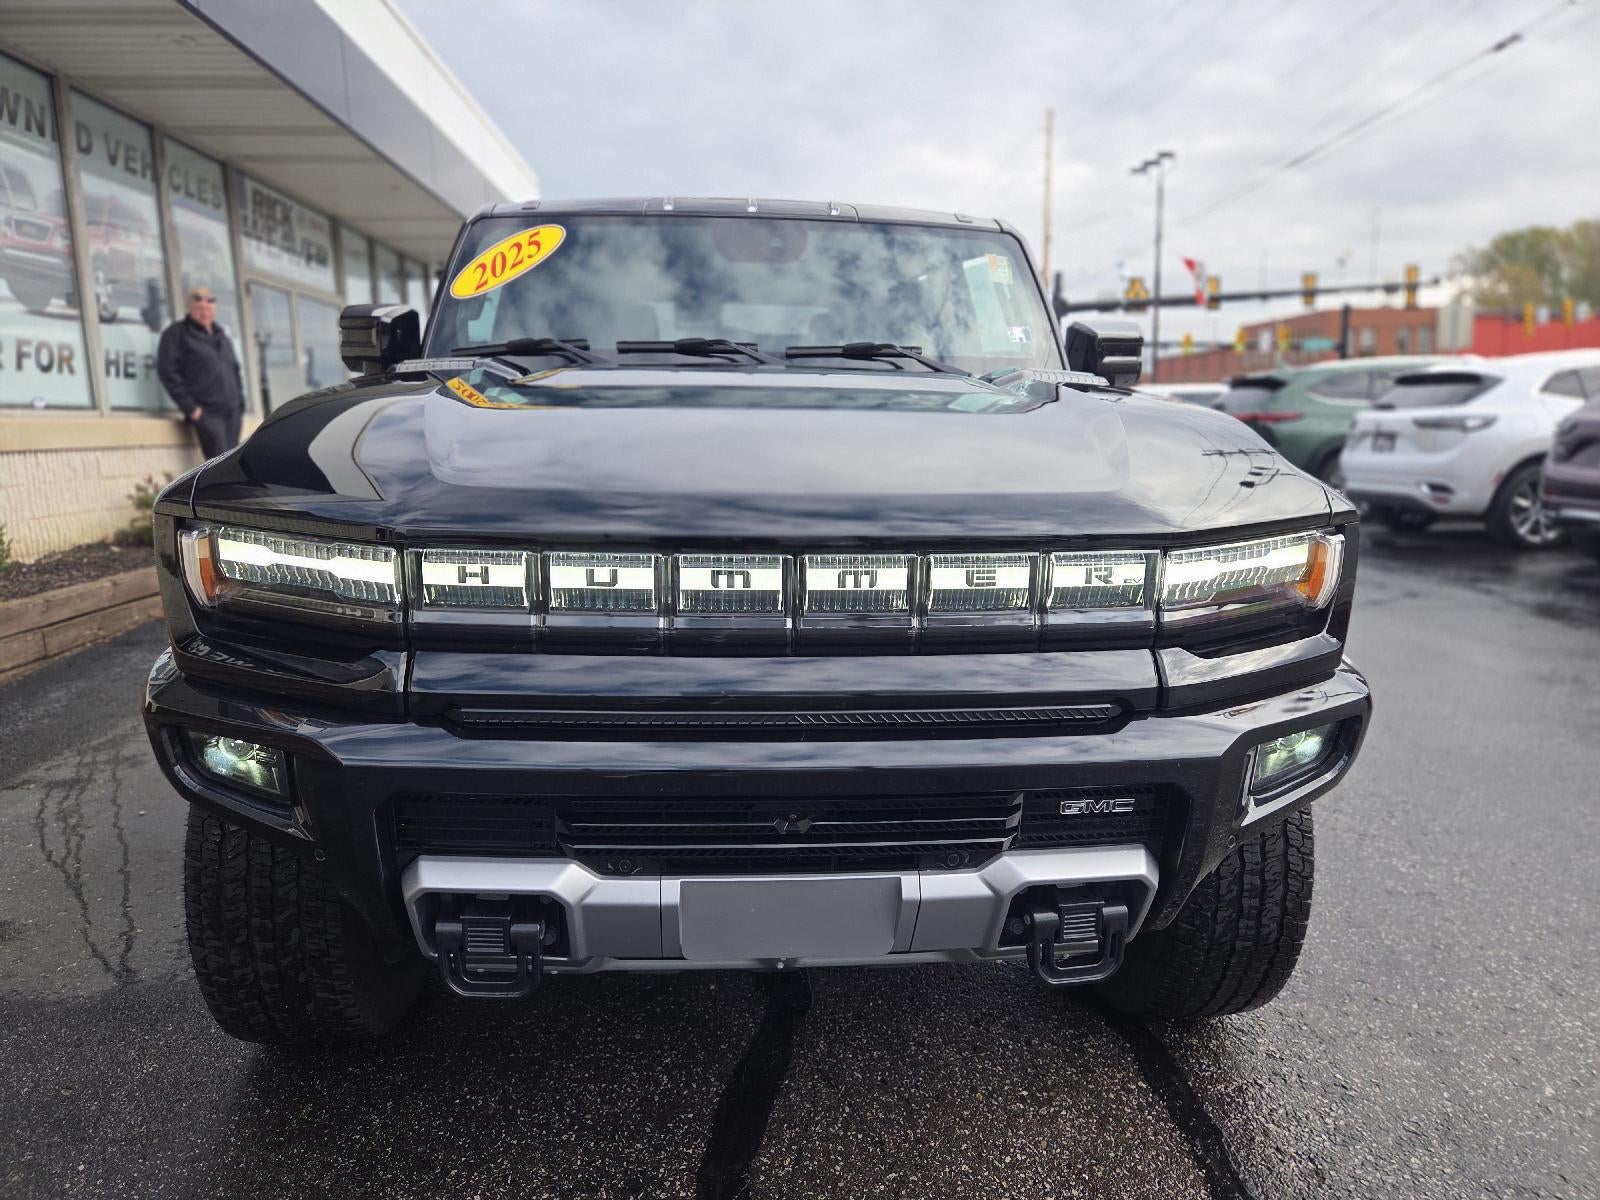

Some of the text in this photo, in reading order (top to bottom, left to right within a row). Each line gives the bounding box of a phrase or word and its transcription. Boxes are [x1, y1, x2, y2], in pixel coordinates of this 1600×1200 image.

[473, 230, 542, 292] 2025
[15, 338, 76, 375] FOR
[105, 348, 138, 380] HE
[458, 565, 1113, 588] HUMMER
[1059, 798, 1136, 815] GMC
